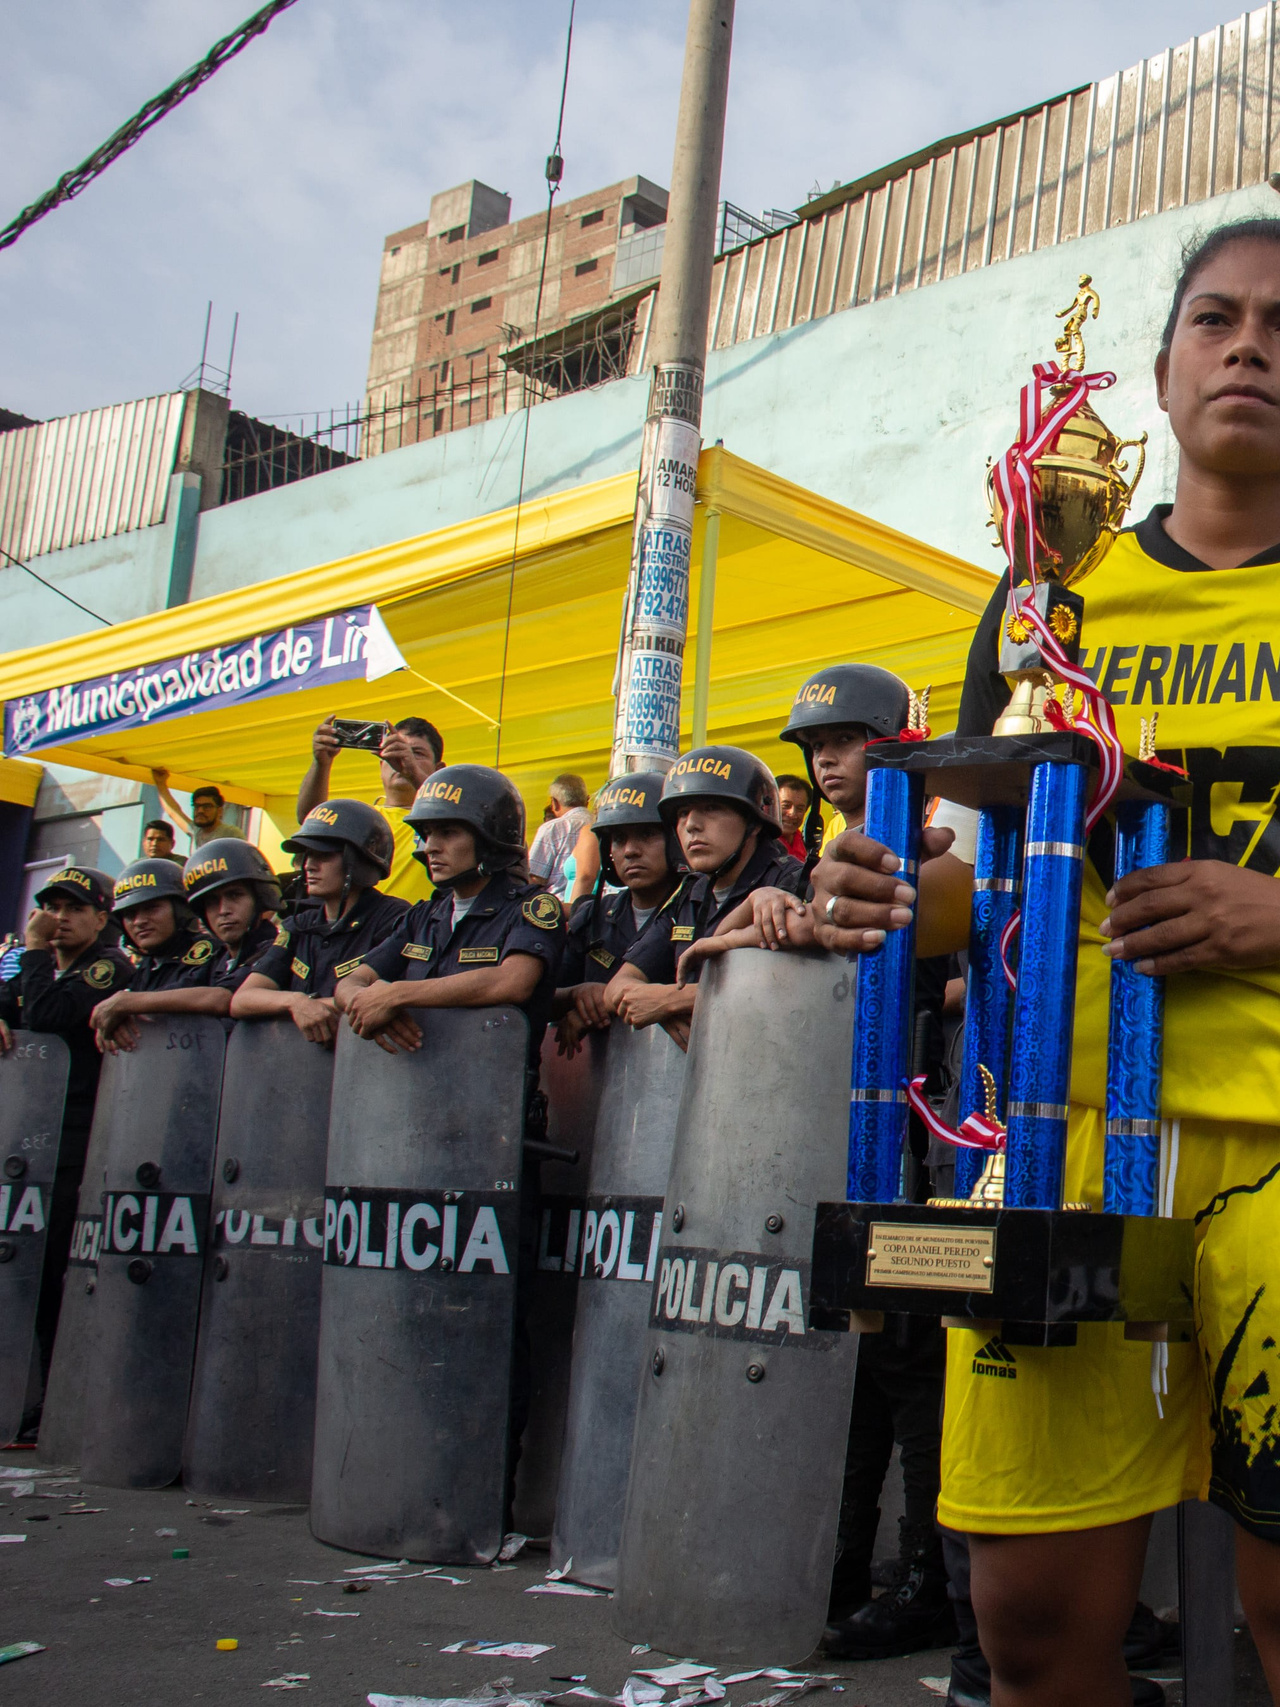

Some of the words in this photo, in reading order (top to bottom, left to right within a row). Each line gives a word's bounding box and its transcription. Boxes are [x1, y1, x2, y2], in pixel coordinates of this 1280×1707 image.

[657, 472, 671, 487] 12
[46, 636, 263, 733] Municipalidad
[270, 627, 313, 680] de
[668, 757, 732, 781] POLICIA
[182, 857, 228, 891] POLICIA
[324, 1198, 510, 1274] POLICIA
[883, 1244, 907, 1253] COPA
[909, 1245, 942, 1255] DANIEL
[944, 1246, 980, 1257] PEREDO
[891, 1256, 934, 1267] SEGUNDO
[935, 1258, 971, 1269] PUESTO
[655, 1257, 806, 1334] POLICIA
